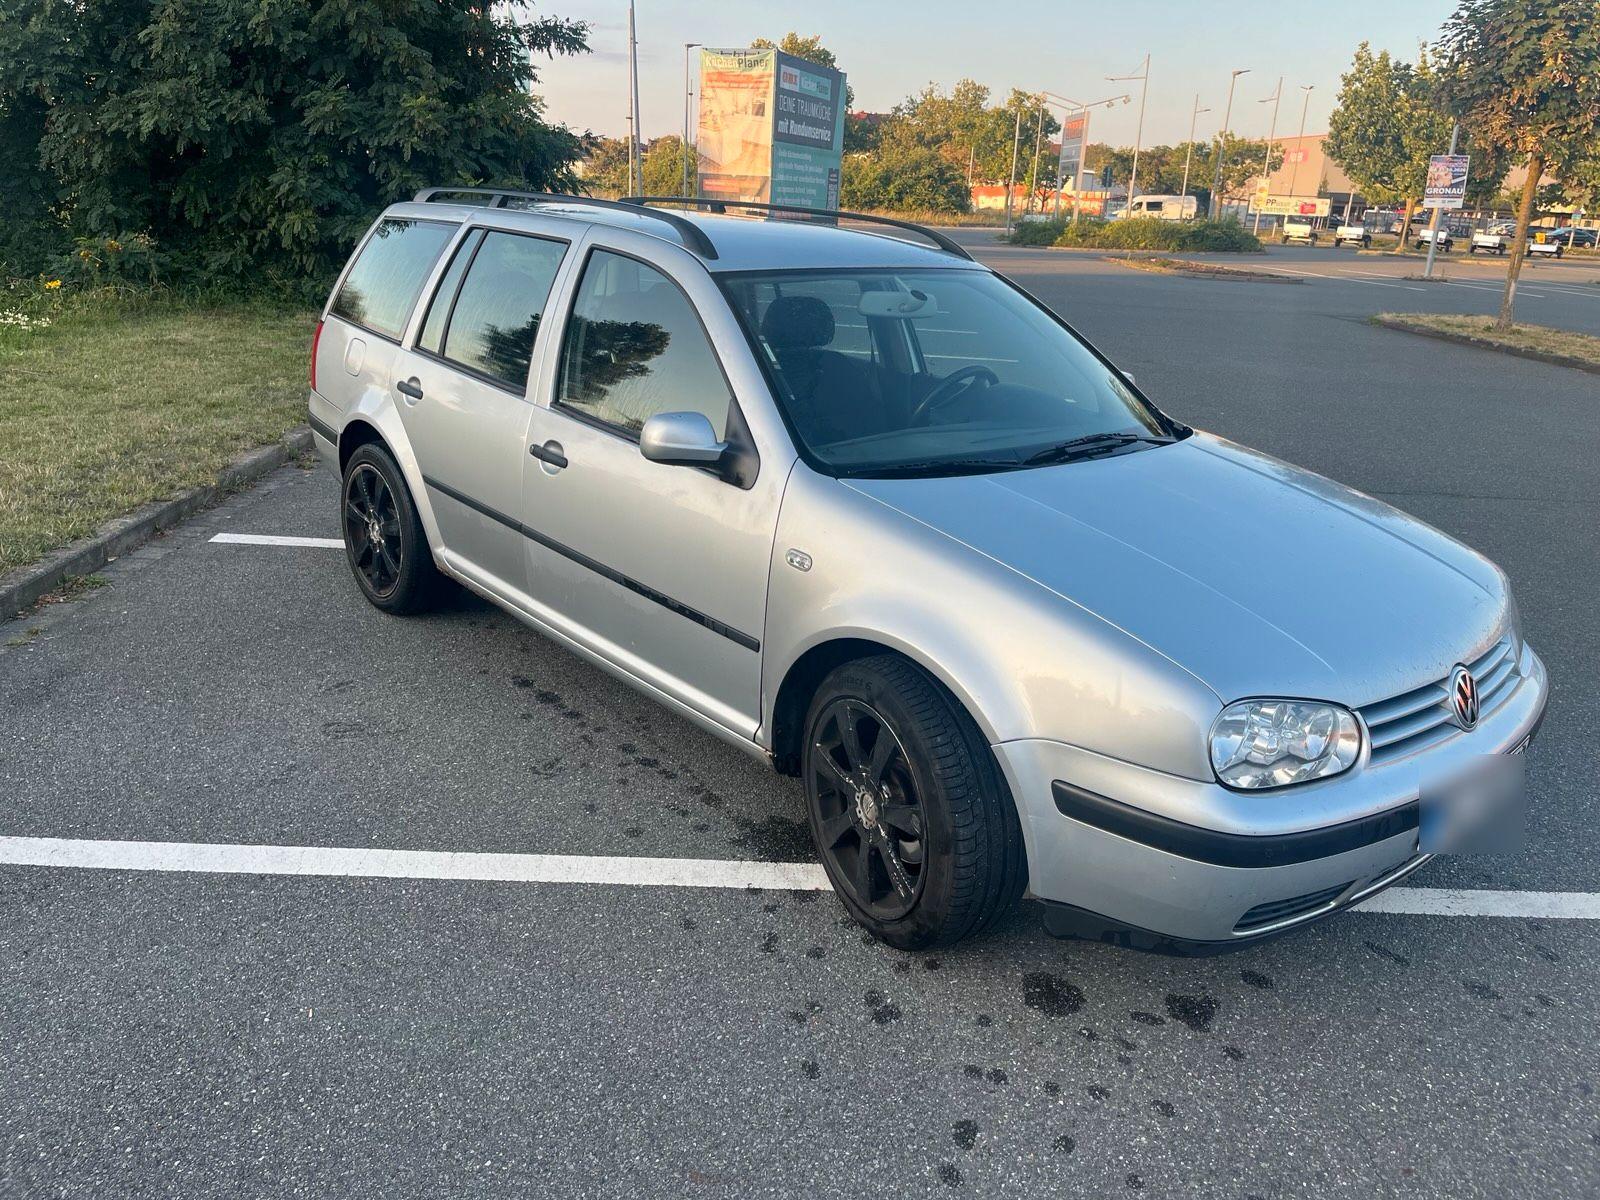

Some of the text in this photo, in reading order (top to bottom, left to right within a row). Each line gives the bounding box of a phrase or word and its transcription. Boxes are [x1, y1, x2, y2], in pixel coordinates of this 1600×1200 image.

[779, 95, 832, 121] DEINE TRAUMKÜCHE
[777, 117, 832, 142] mit Rundumservice
[1426, 187, 1464, 195] GRONAU
